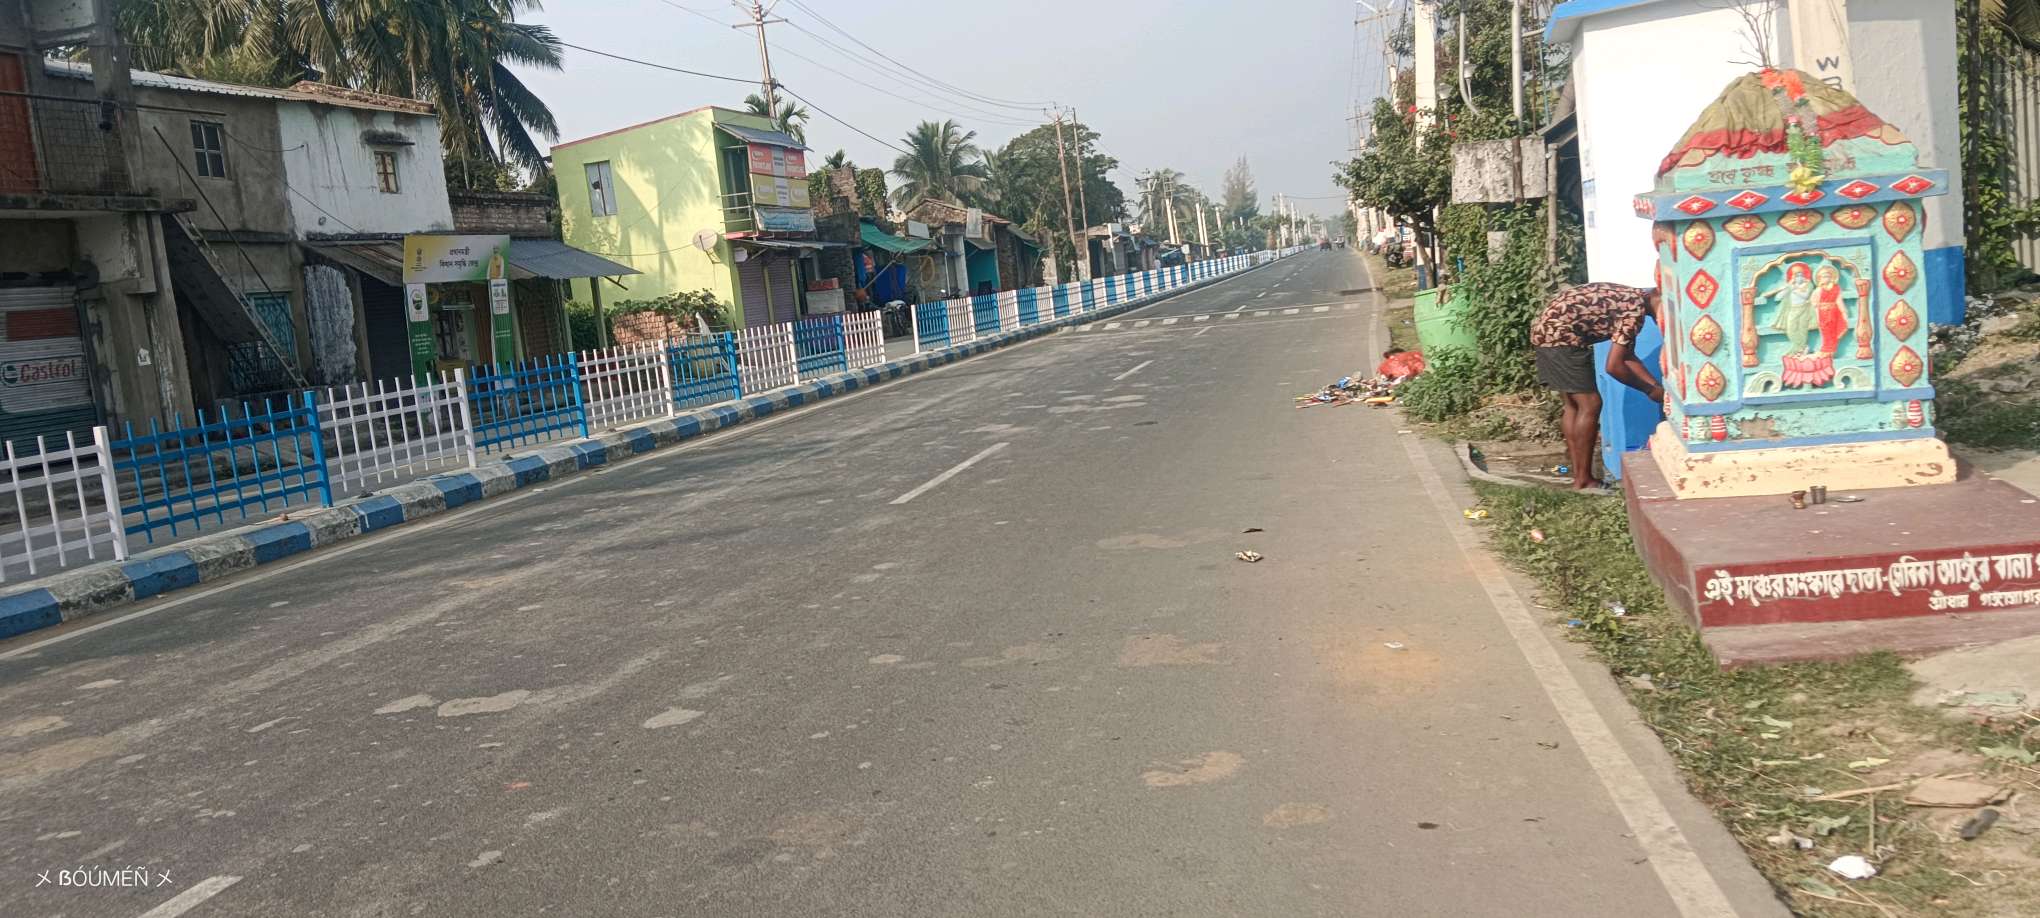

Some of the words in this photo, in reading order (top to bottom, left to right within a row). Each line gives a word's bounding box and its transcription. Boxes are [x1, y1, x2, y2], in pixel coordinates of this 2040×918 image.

[20, 359, 77, 383] Castrol
[1704, 569, 1735, 606] এই
[1784, 571, 1845, 599] সংস্কারে
[1991, 553, 2033, 581] বালা
